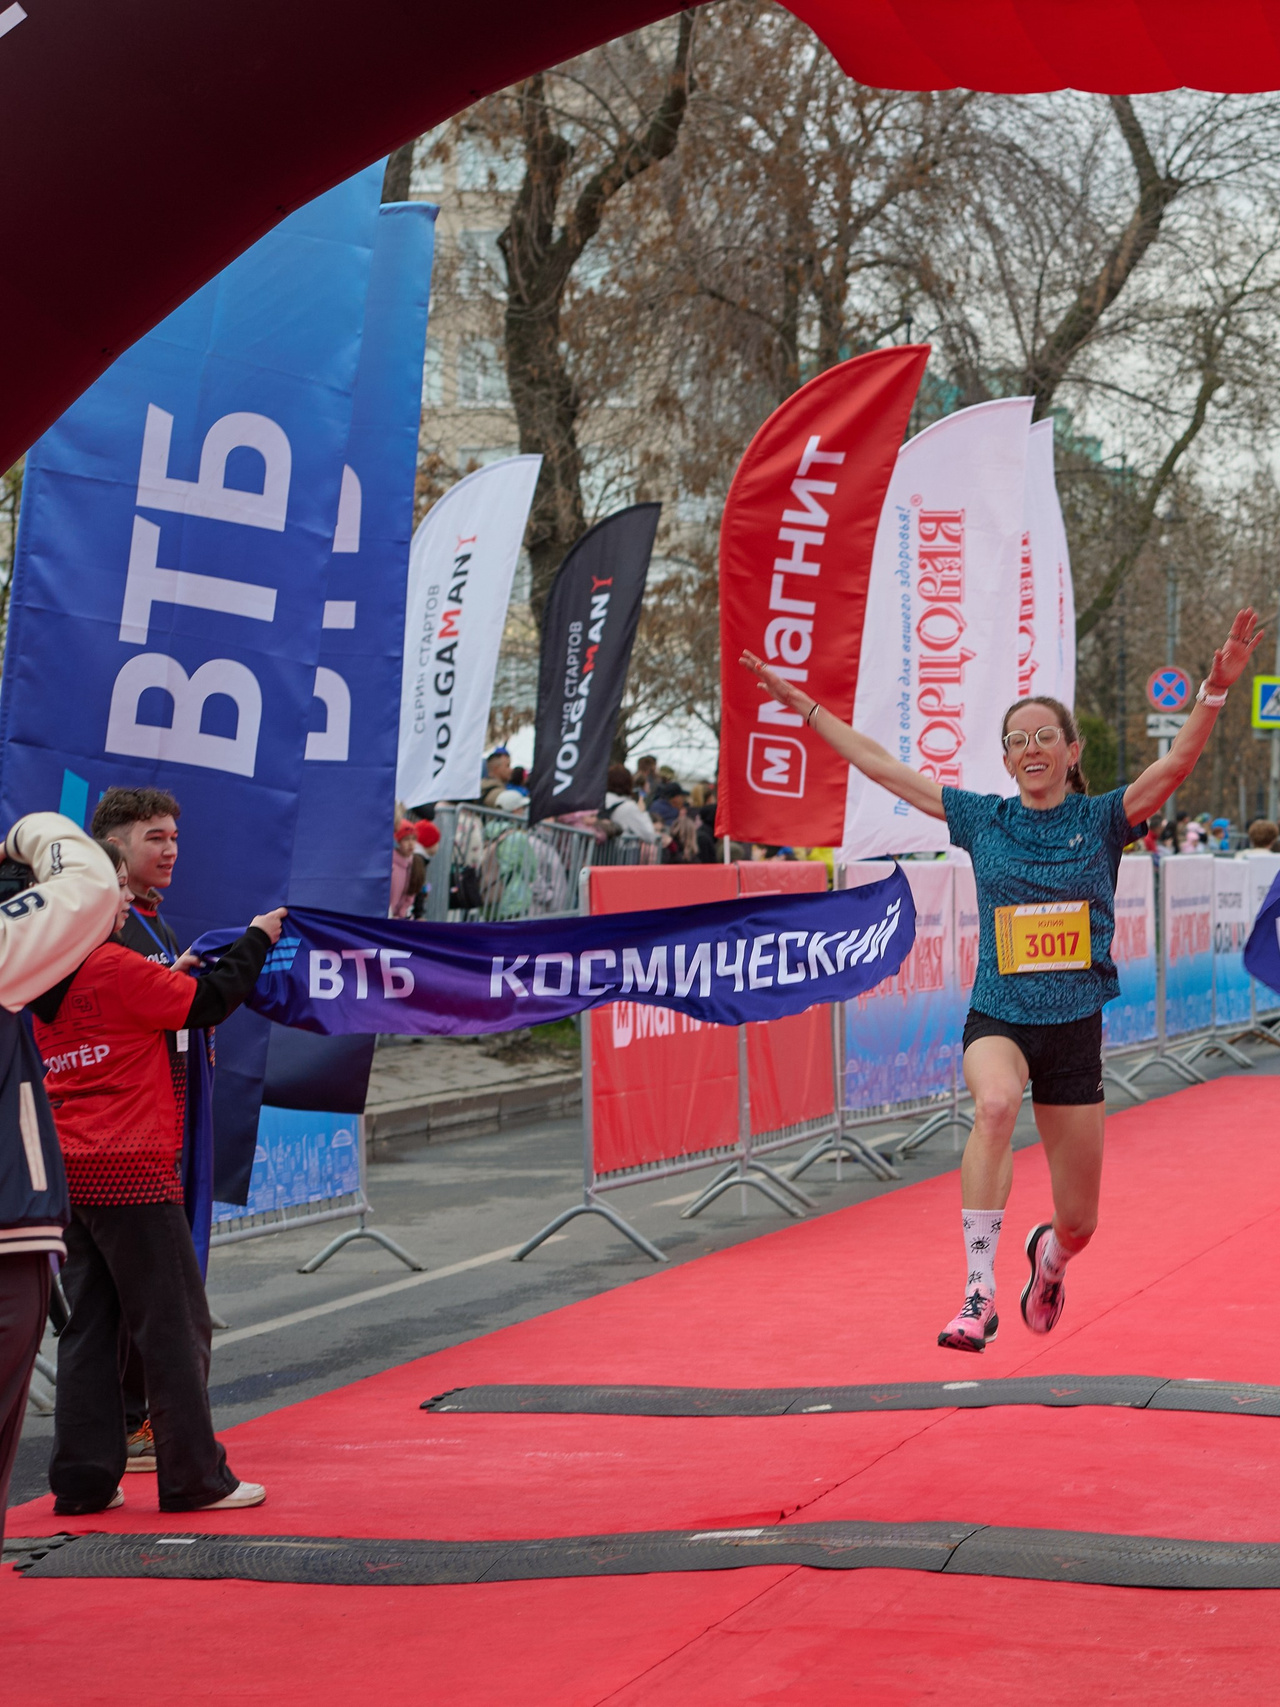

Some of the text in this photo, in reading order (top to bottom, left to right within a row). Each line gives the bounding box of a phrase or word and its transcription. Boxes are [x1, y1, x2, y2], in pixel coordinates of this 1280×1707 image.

[894, 505, 912, 589] здоровья!
[105, 402, 292, 777] ВТБ
[419, 584, 440, 668] СТАРТОВ
[899, 593, 912, 653] вашего
[564, 621, 583, 698] СТАРТОВ
[897, 658, 911, 686] для
[896, 692, 911, 731] вода
[309, 948, 415, 1000] ВТБ
[490, 898, 901, 998] КОСМИЧЕСКИЙ
[1025, 931, 1080, 958] 3017
